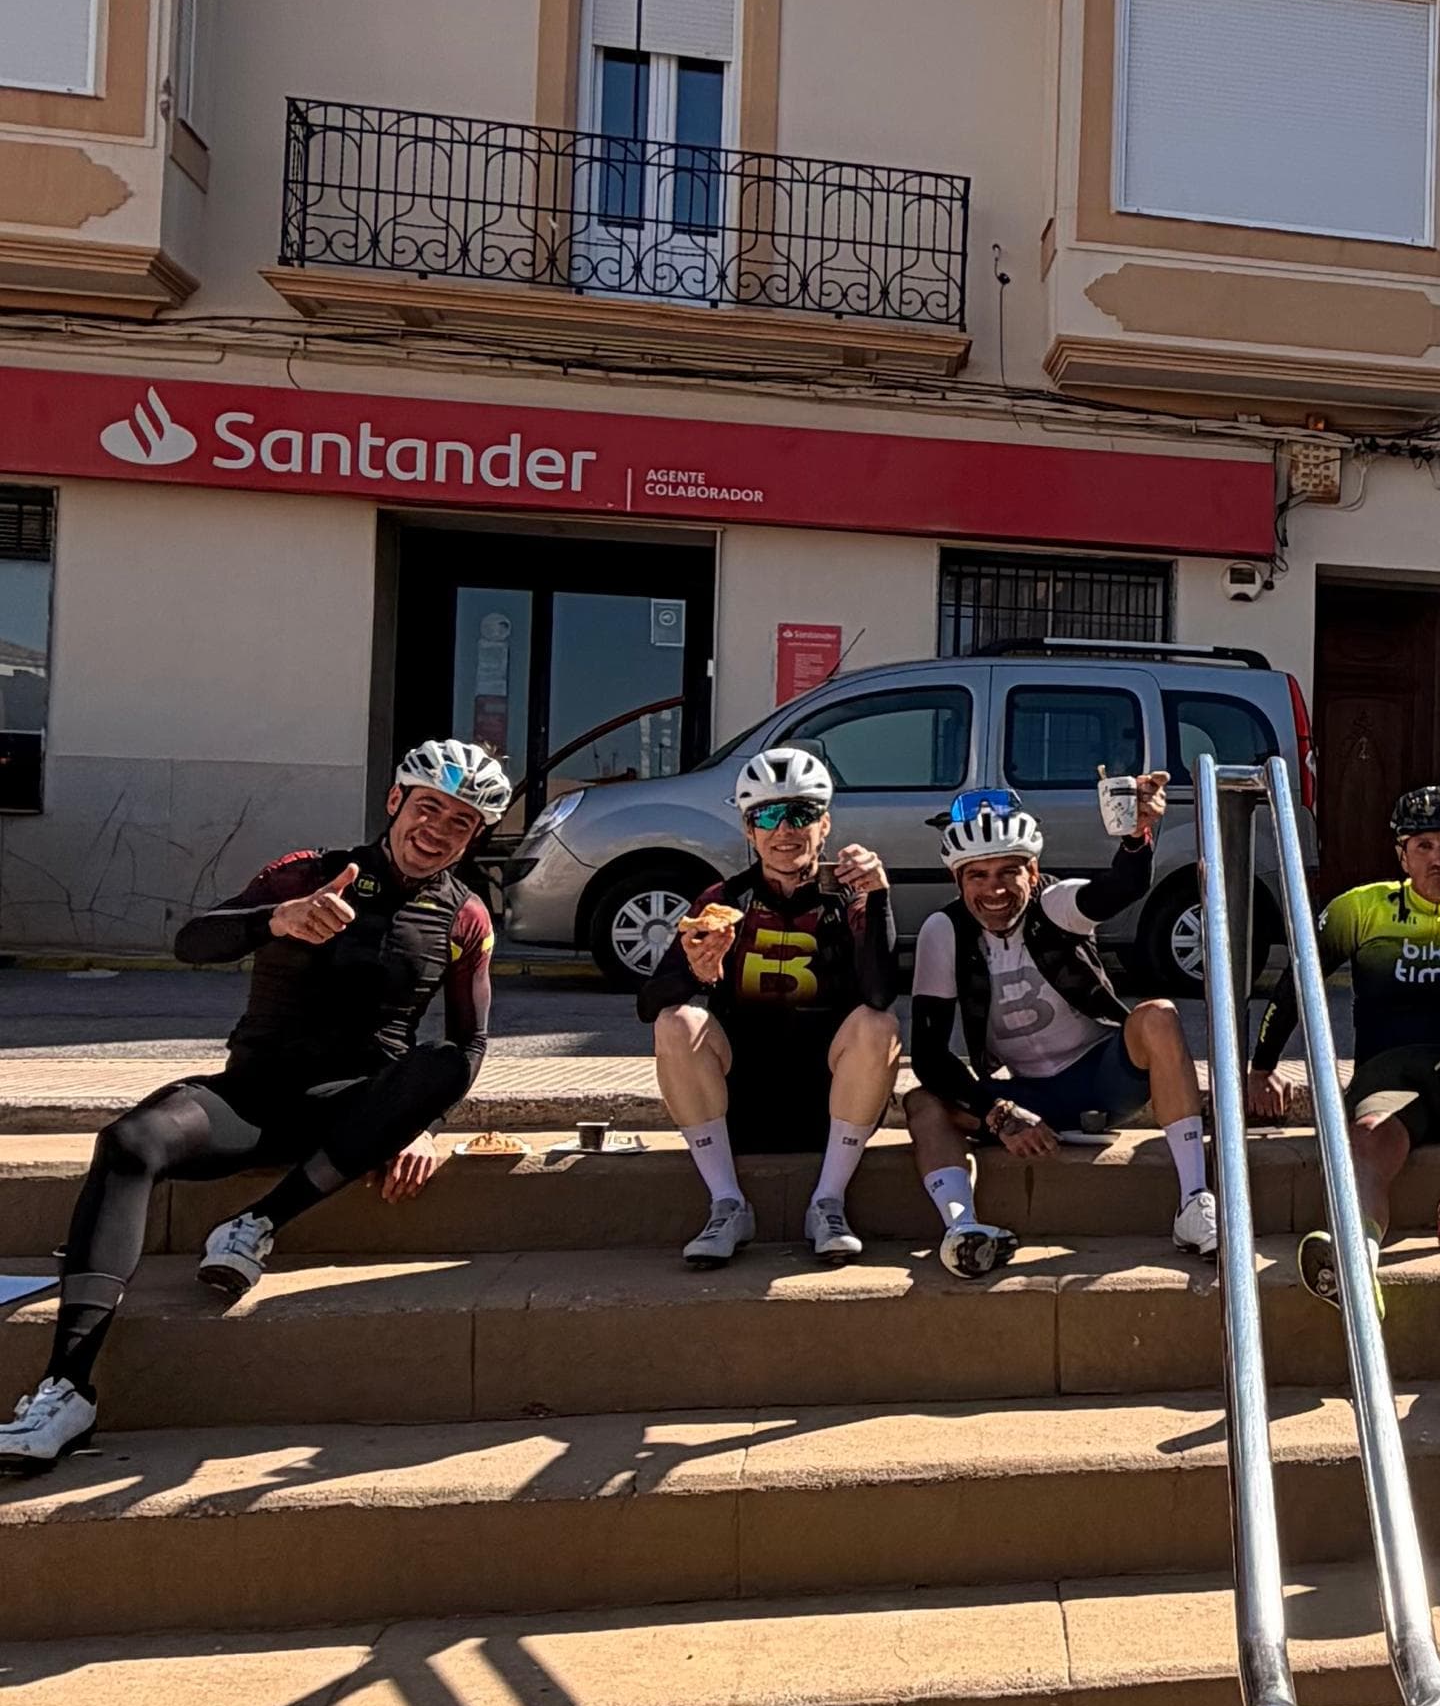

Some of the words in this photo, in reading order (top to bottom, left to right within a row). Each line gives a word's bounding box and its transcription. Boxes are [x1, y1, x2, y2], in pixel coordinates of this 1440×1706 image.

[212, 411, 597, 492] Santander
[645, 469, 706, 485] AGENTE
[644, 483, 764, 503] COLABORADOR
